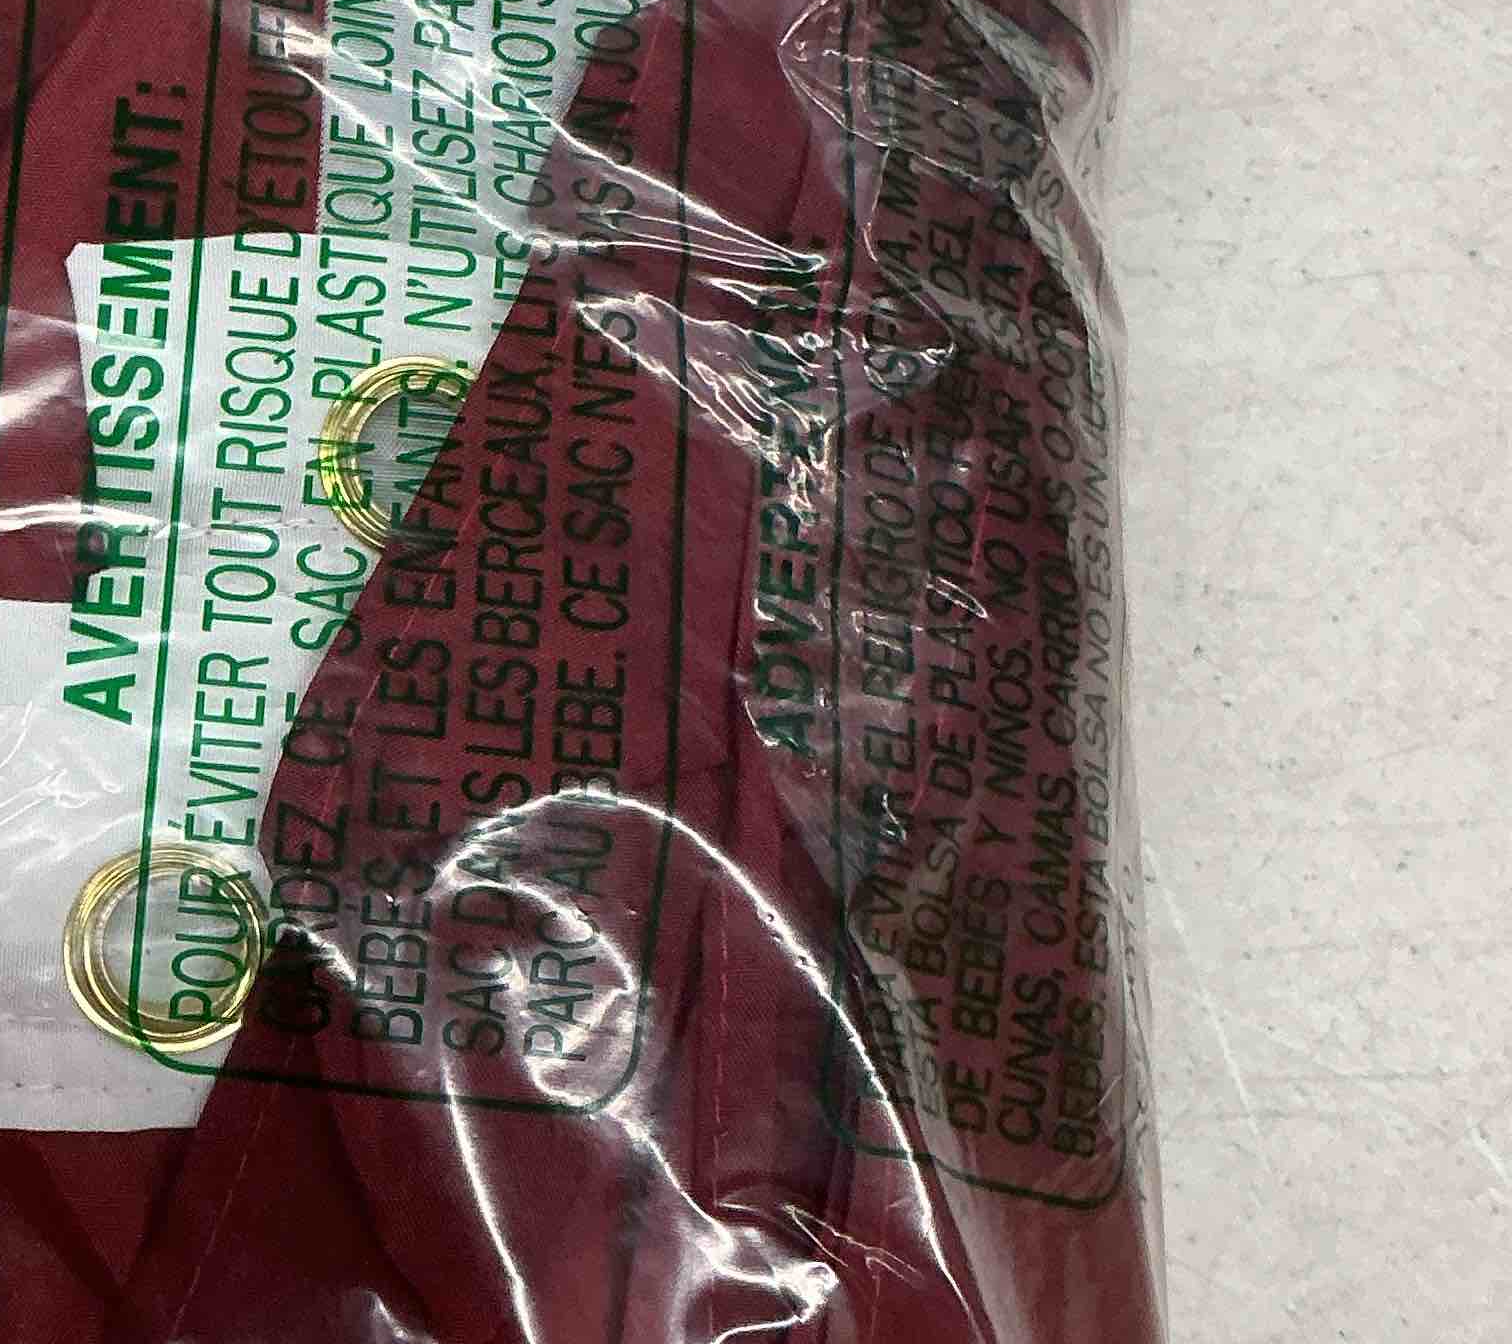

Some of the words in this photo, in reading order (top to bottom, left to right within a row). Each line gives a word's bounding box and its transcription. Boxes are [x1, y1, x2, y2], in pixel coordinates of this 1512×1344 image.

[578, 94, 635, 165] UN
[984, 95, 1044, 242] BLSA
[402, 69, 481, 331] N'UTILISEZ
[576, 178, 636, 256] PAS
[310, 116, 399, 400] PLASTIQUE
[927, 215, 973, 296] DEL
[212, 269, 298, 474] RISQUE
[573, 272, 638, 424] N'EST
[984, 266, 1027, 373] ESTA
[62, 81, 186, 725] AVERTISSEMENT:
[864, 413, 913, 490] DE
[1041, 427, 1075, 463] O
[302, 441, 377, 508] EN
[384, 361, 469, 609] ENFANTS.
[472, 354, 557, 648] BERCEAUX,
[560, 441, 633, 549] SAC
[984, 393, 1034, 524] USAR
[1081, 463, 1110, 526] UN
[201, 488, 283, 632] TOUT
[289, 544, 368, 651] SAC
[559, 558, 630, 633] CE
[864, 495, 913, 707] PELIGRO
[989, 542, 1030, 616] NO
[1078, 533, 1114, 601] ES
[375, 638, 452, 739] LES
[1081, 608, 1114, 684] NO
[168, 652, 270, 847] ÉVITER
[283, 692, 360, 767] CE
[467, 655, 538, 758] LES
[864, 719, 916, 774] EL
[930, 718, 976, 799] DE
[368, 756, 441, 834] ET
[1078, 693, 1117, 846] BOLSA
[455, 771, 533, 927] DANS
[543, 822, 616, 896] AU
[978, 819, 1019, 849] Y
[1024, 768, 1078, 945] CAMAS,
[168, 869, 251, 1023] POUR
[257, 801, 352, 1035] GARDEZ
[907, 817, 966, 977] BOLSA
[1075, 856, 1114, 974] ESTA
[442, 943, 509, 1056] SAC
[524, 934, 598, 1060] PARC
[920, 997, 942, 1116] ESTA
[945, 1068, 991, 1134] DE
[995, 969, 1066, 1145] CUNAS,
